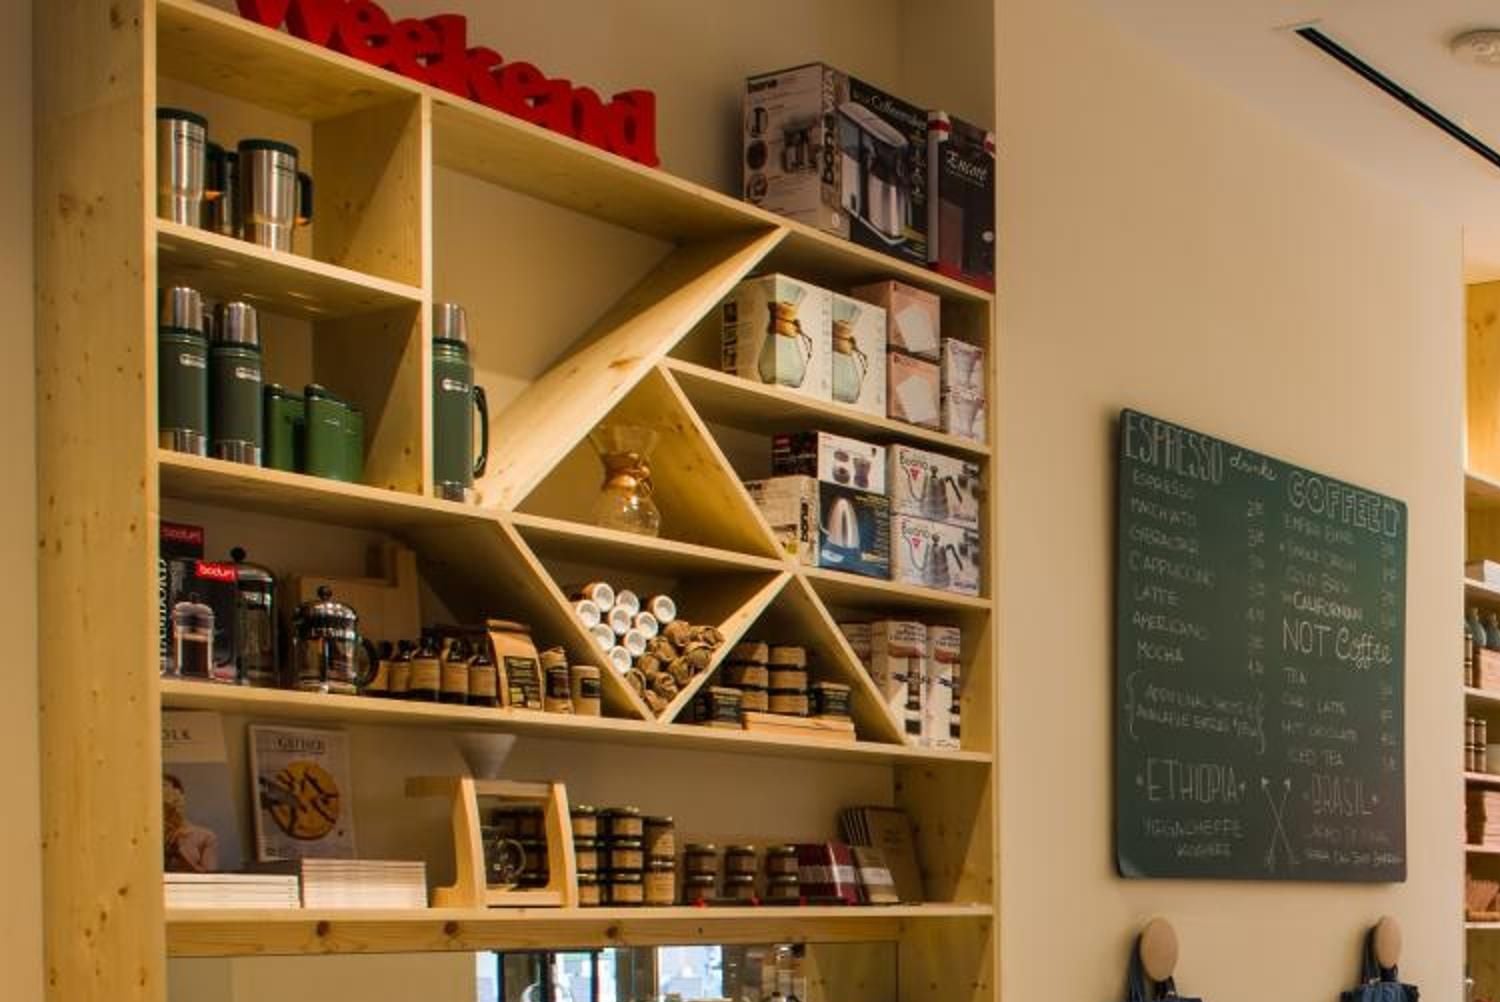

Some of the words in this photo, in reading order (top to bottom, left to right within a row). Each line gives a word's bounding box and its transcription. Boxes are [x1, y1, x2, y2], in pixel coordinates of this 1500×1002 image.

[1123, 412, 1224, 486] ESPRESSO
[1282, 616, 1332, 657] NOT
[1335, 625, 1393, 671] Coffee
[1146, 757, 1239, 803] ETHIOPIA
